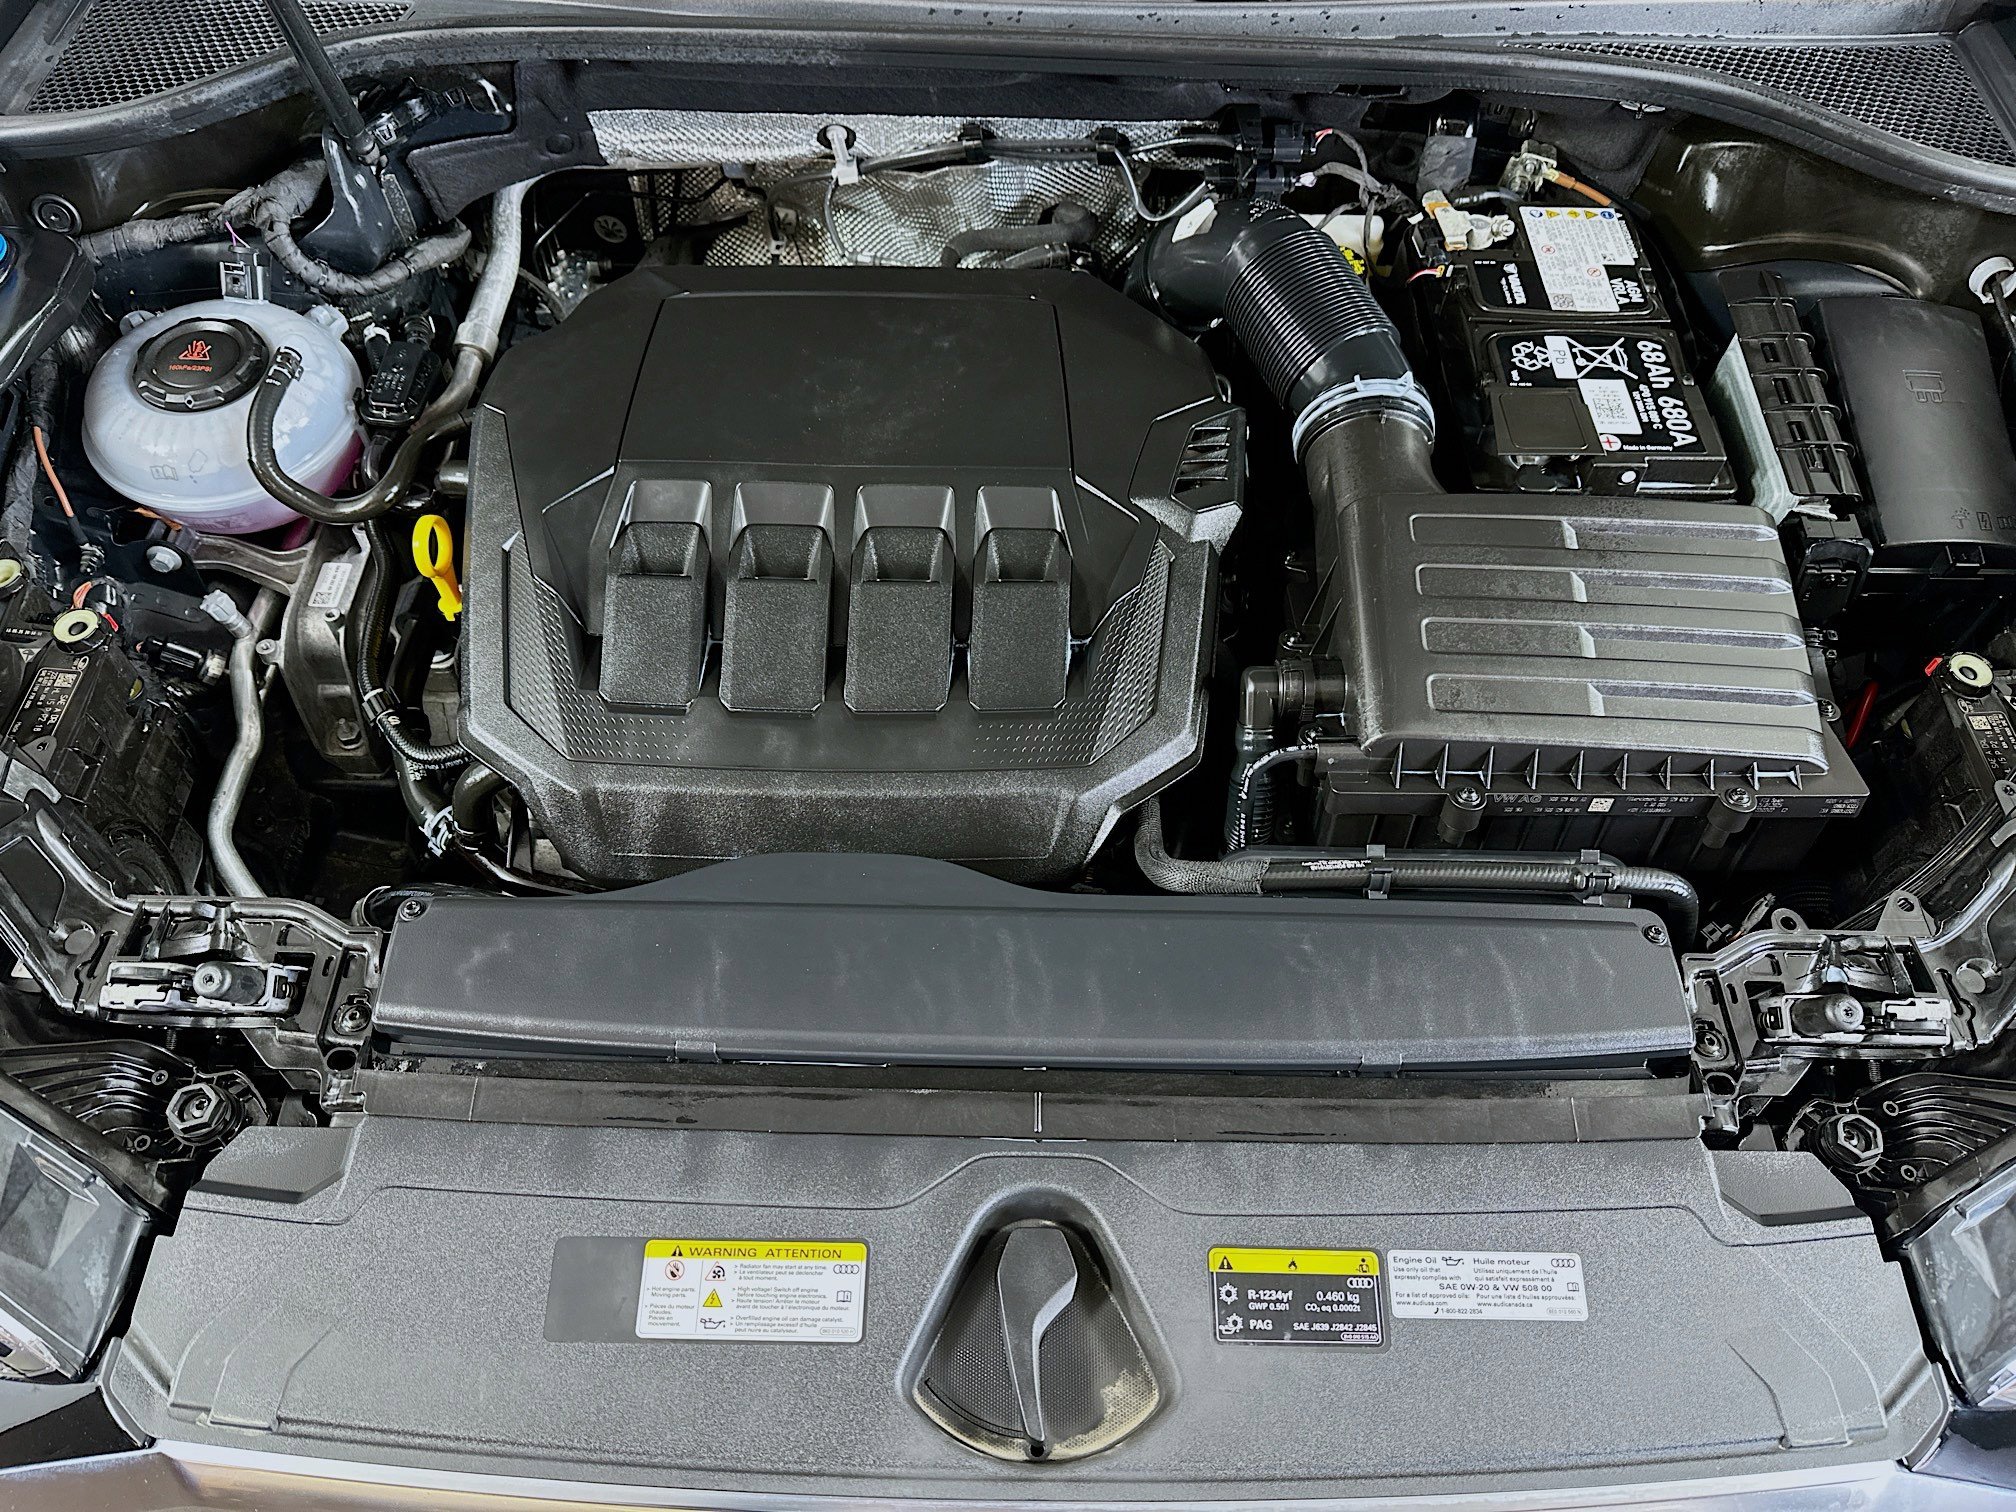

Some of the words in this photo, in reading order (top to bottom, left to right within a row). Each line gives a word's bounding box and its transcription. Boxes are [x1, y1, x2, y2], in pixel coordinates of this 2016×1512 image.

[1610, 277, 1630, 305] VRLA
[1623, 279, 1644, 303] AGM
[1553, 350, 1567, 364] Pb
[1637, 340, 1674, 389] 68Ah
[1657, 396, 1697, 447] 680A
[57, 694, 68, 705] SAE
[1494, 794, 1518, 802] VW
[1518, 794, 1542, 803] AG
[689, 1248, 757, 1257] WARNING
[766, 1249, 841, 1258] ATTENTION
[1393, 1256, 1422, 1264] Engine
[1247, 1289, 1293, 1302] R-1234yf
[1316, 1291, 1344, 1302] 0.460
[1347, 1292, 1360, 1303] kg
[1321, 1305, 1331, 1313] eq
[1333, 1304, 1361, 1312] 0.0002t
[1249, 1320, 1272, 1330] PAG
[1293, 1323, 1309, 1331] SAE
[1311, 1323, 1329, 1331] J639
[1331, 1323, 1353, 1331] J2842
[1354, 1323, 1377, 1332] J2845
